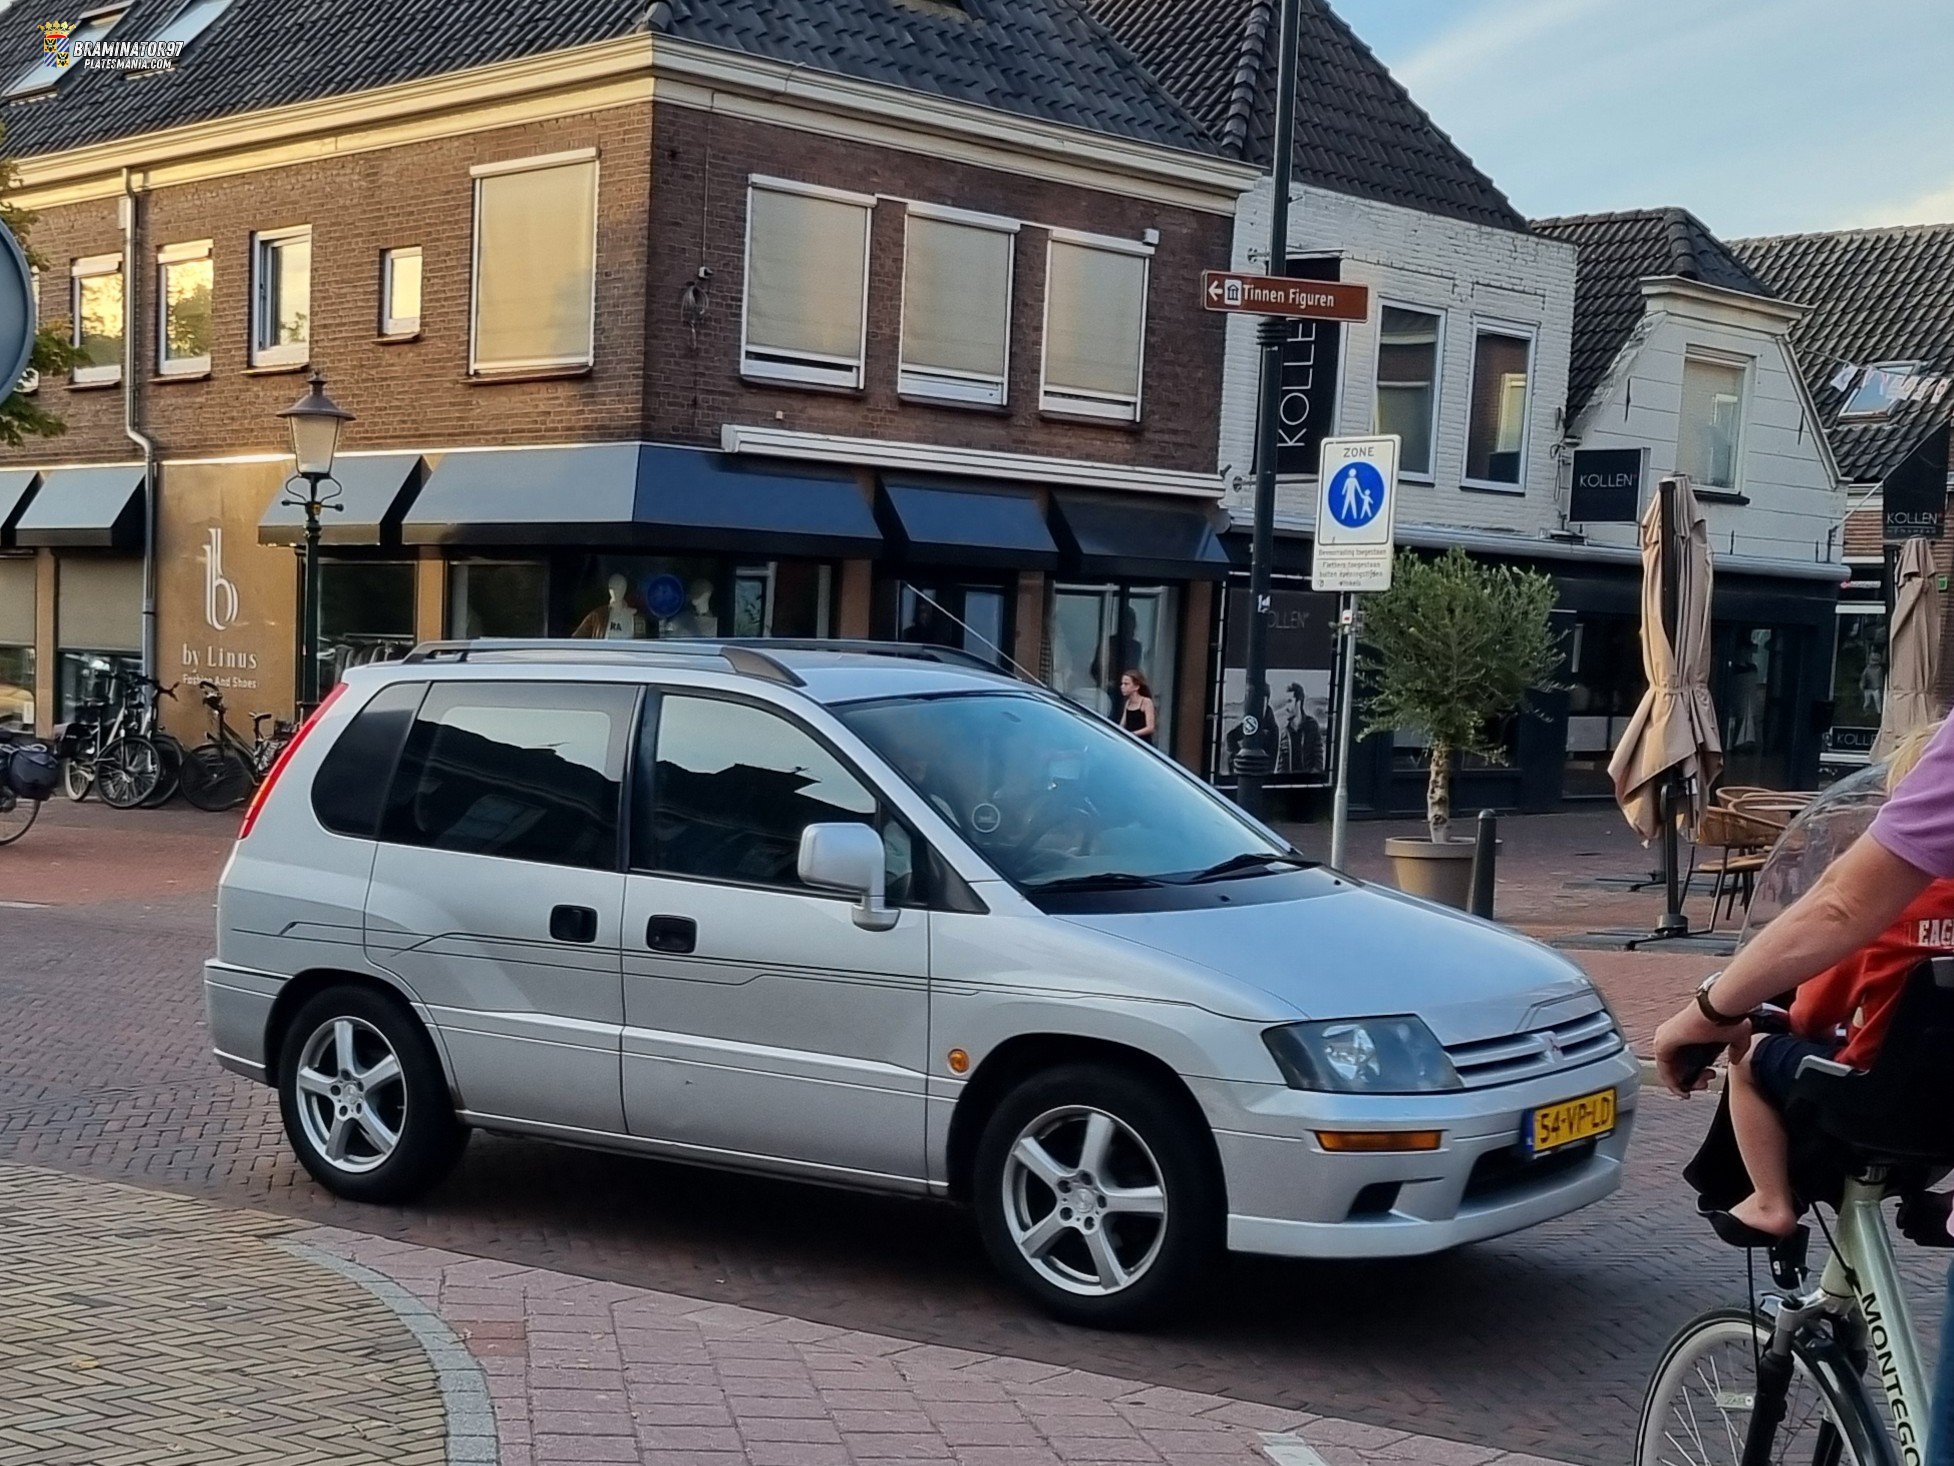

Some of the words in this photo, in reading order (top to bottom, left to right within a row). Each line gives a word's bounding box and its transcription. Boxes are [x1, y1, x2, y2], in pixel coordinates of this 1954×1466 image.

[1243, 284, 1285, 303] Tinnen
[1289, 288, 1334, 309] Figuren
[1277, 317, 1316, 446] KOLLE
[1343, 447, 1374, 458] ZONE
[1580, 473, 1632, 487] KOLLEN
[1887, 511, 1938, 525] KOLLEN
[182, 643, 199, 673] by
[207, 646, 257, 669] Linus
[232, 677, 257, 688] Shoes
[1540, 1097, 1610, 1143] 54-VP-LD
[1862, 1292, 1921, 1466] MONTEGO
